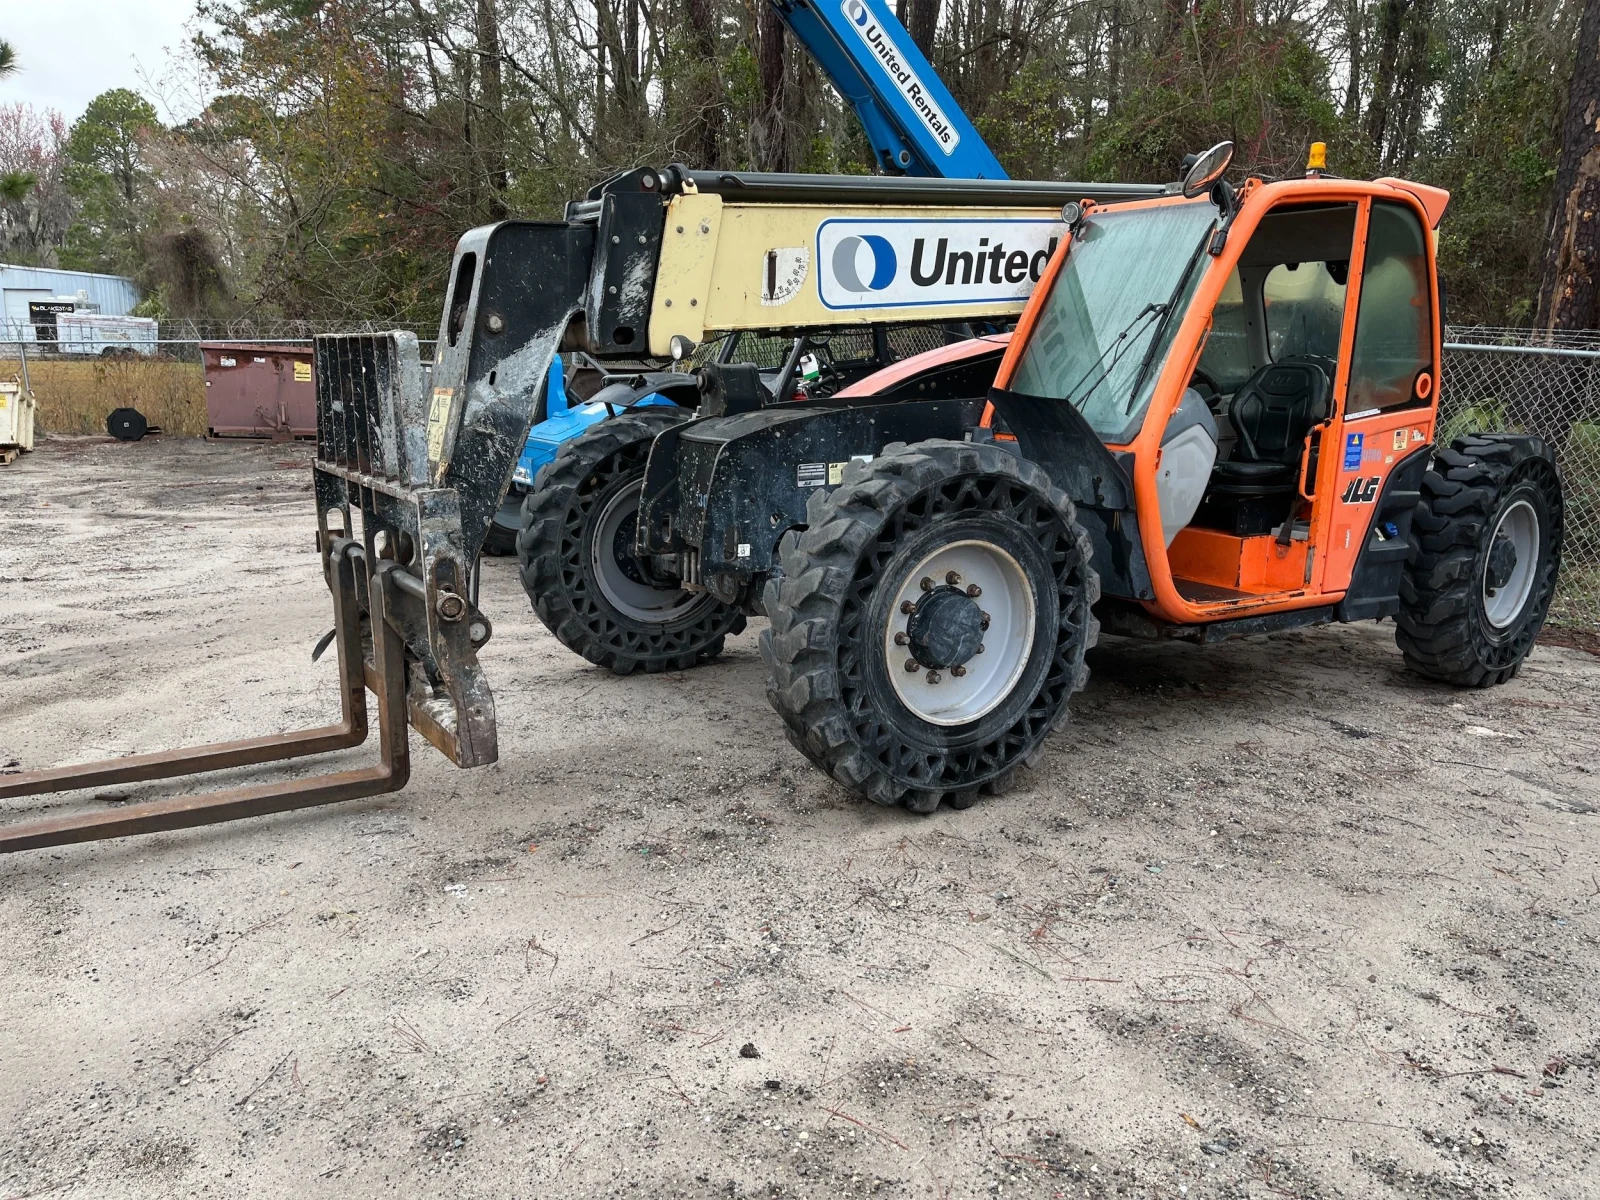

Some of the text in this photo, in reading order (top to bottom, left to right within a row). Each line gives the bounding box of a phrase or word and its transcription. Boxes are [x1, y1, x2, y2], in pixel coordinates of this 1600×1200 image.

[865, 24, 952, 144] United Rentals
[910, 237, 1059, 286] United
[1340, 475, 1381, 505] JLG
